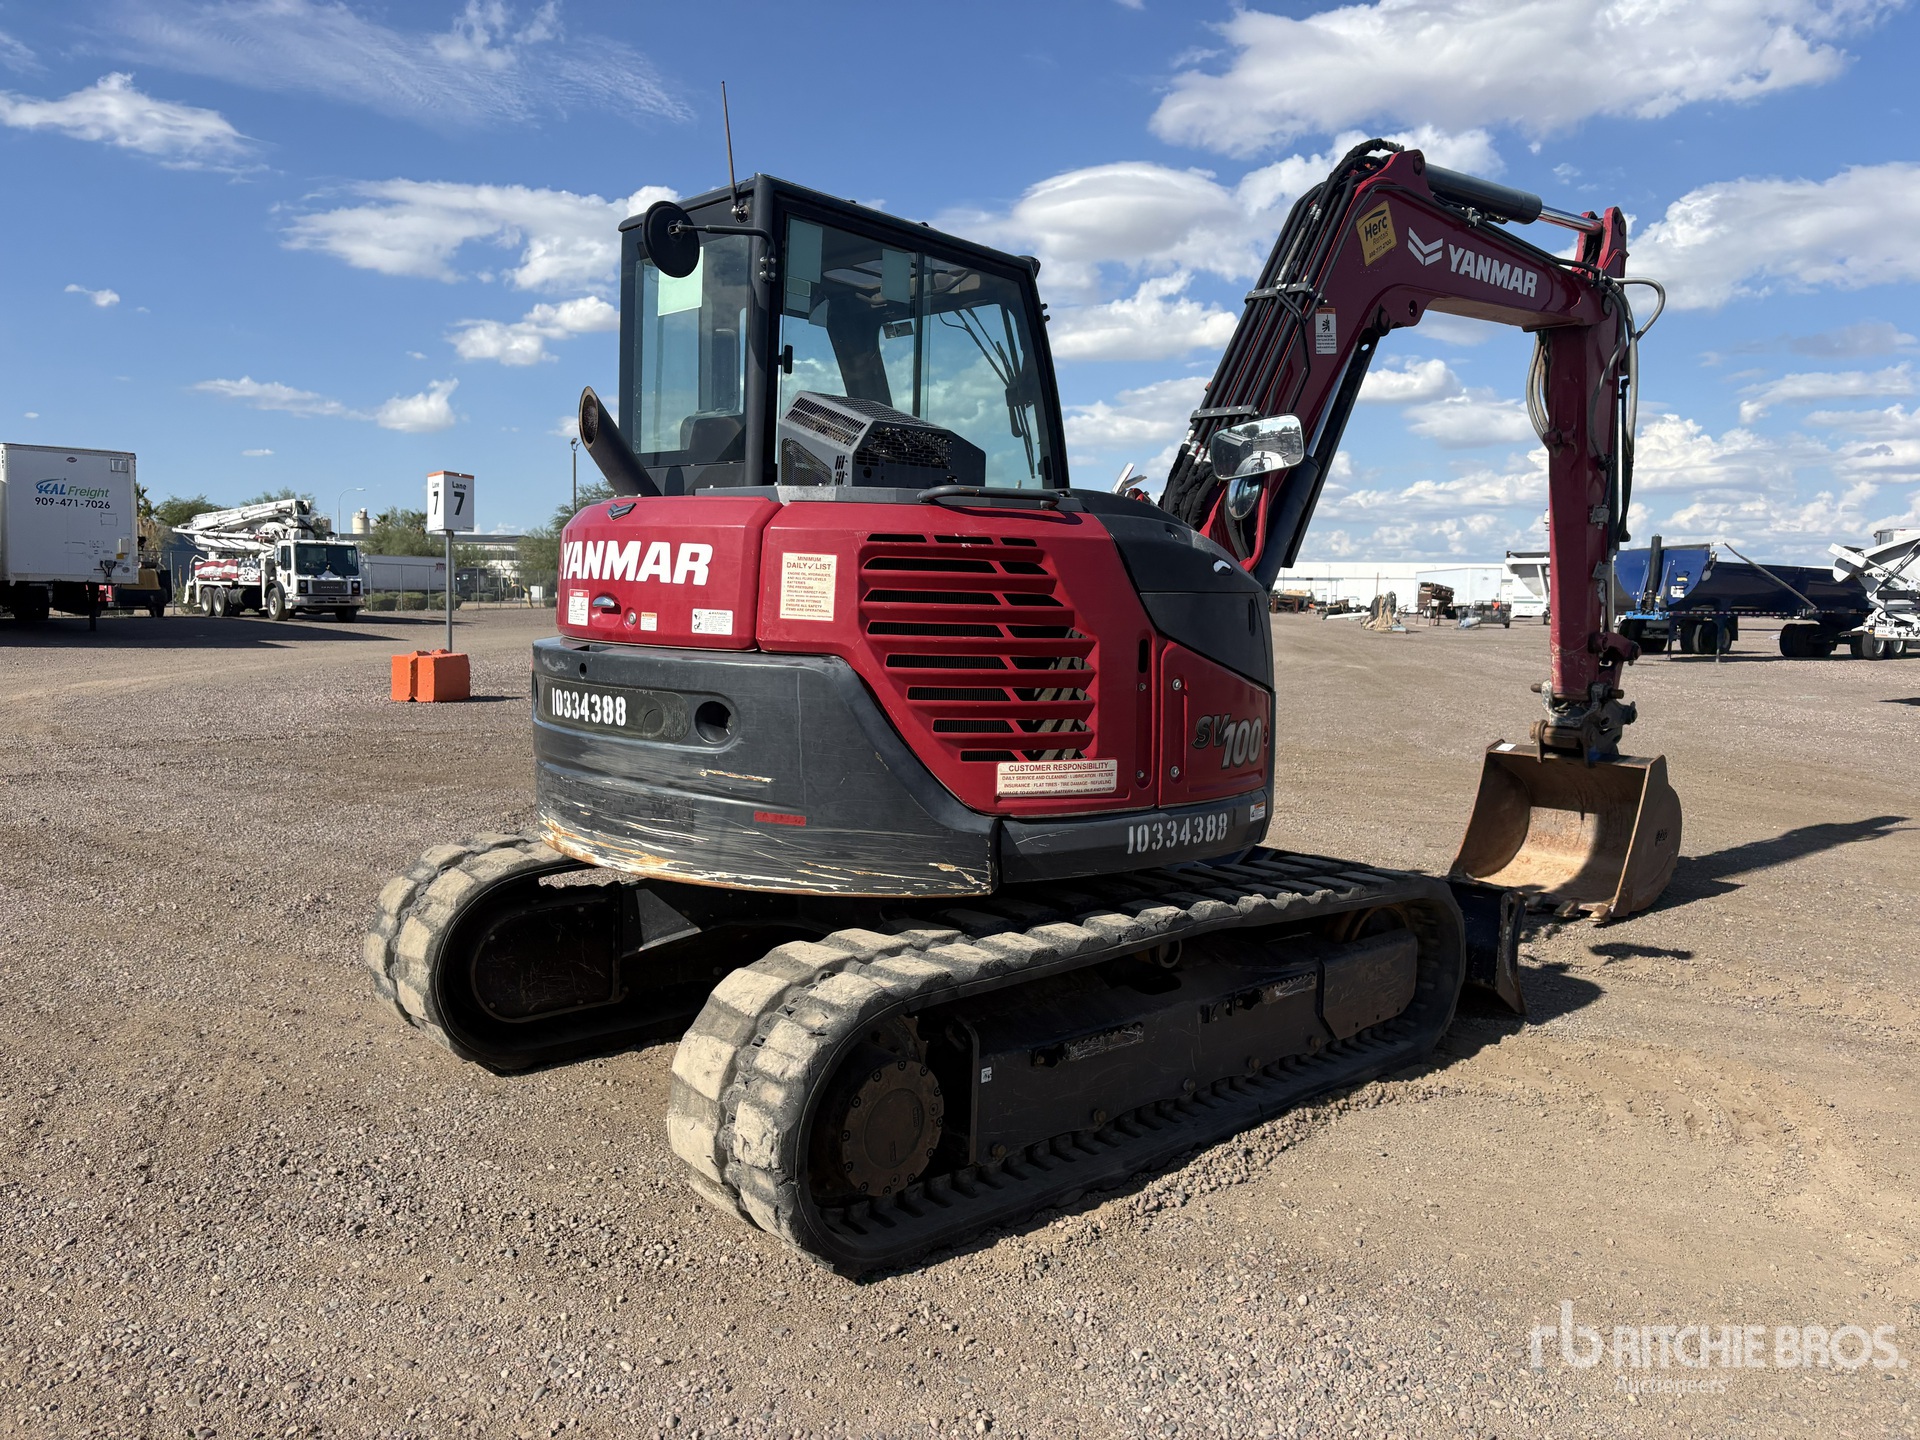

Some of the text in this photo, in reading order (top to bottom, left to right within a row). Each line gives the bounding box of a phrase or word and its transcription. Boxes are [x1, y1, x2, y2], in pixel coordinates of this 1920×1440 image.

[1364, 216, 1388, 242] Herc
[1448, 244, 1538, 298] YANMAR
[68, 486, 110, 500] Freight
[452, 481, 466, 490] Lane
[35, 497, 110, 510] 909-471-7026
[454, 491, 465, 516] 7
[562, 540, 714, 586] YANMAR
[552, 688, 627, 726] 10334388
[1008, 762, 1109, 772] CUSTOMER RESPONSIBILITY
[1127, 812, 1228, 854] 10334388
